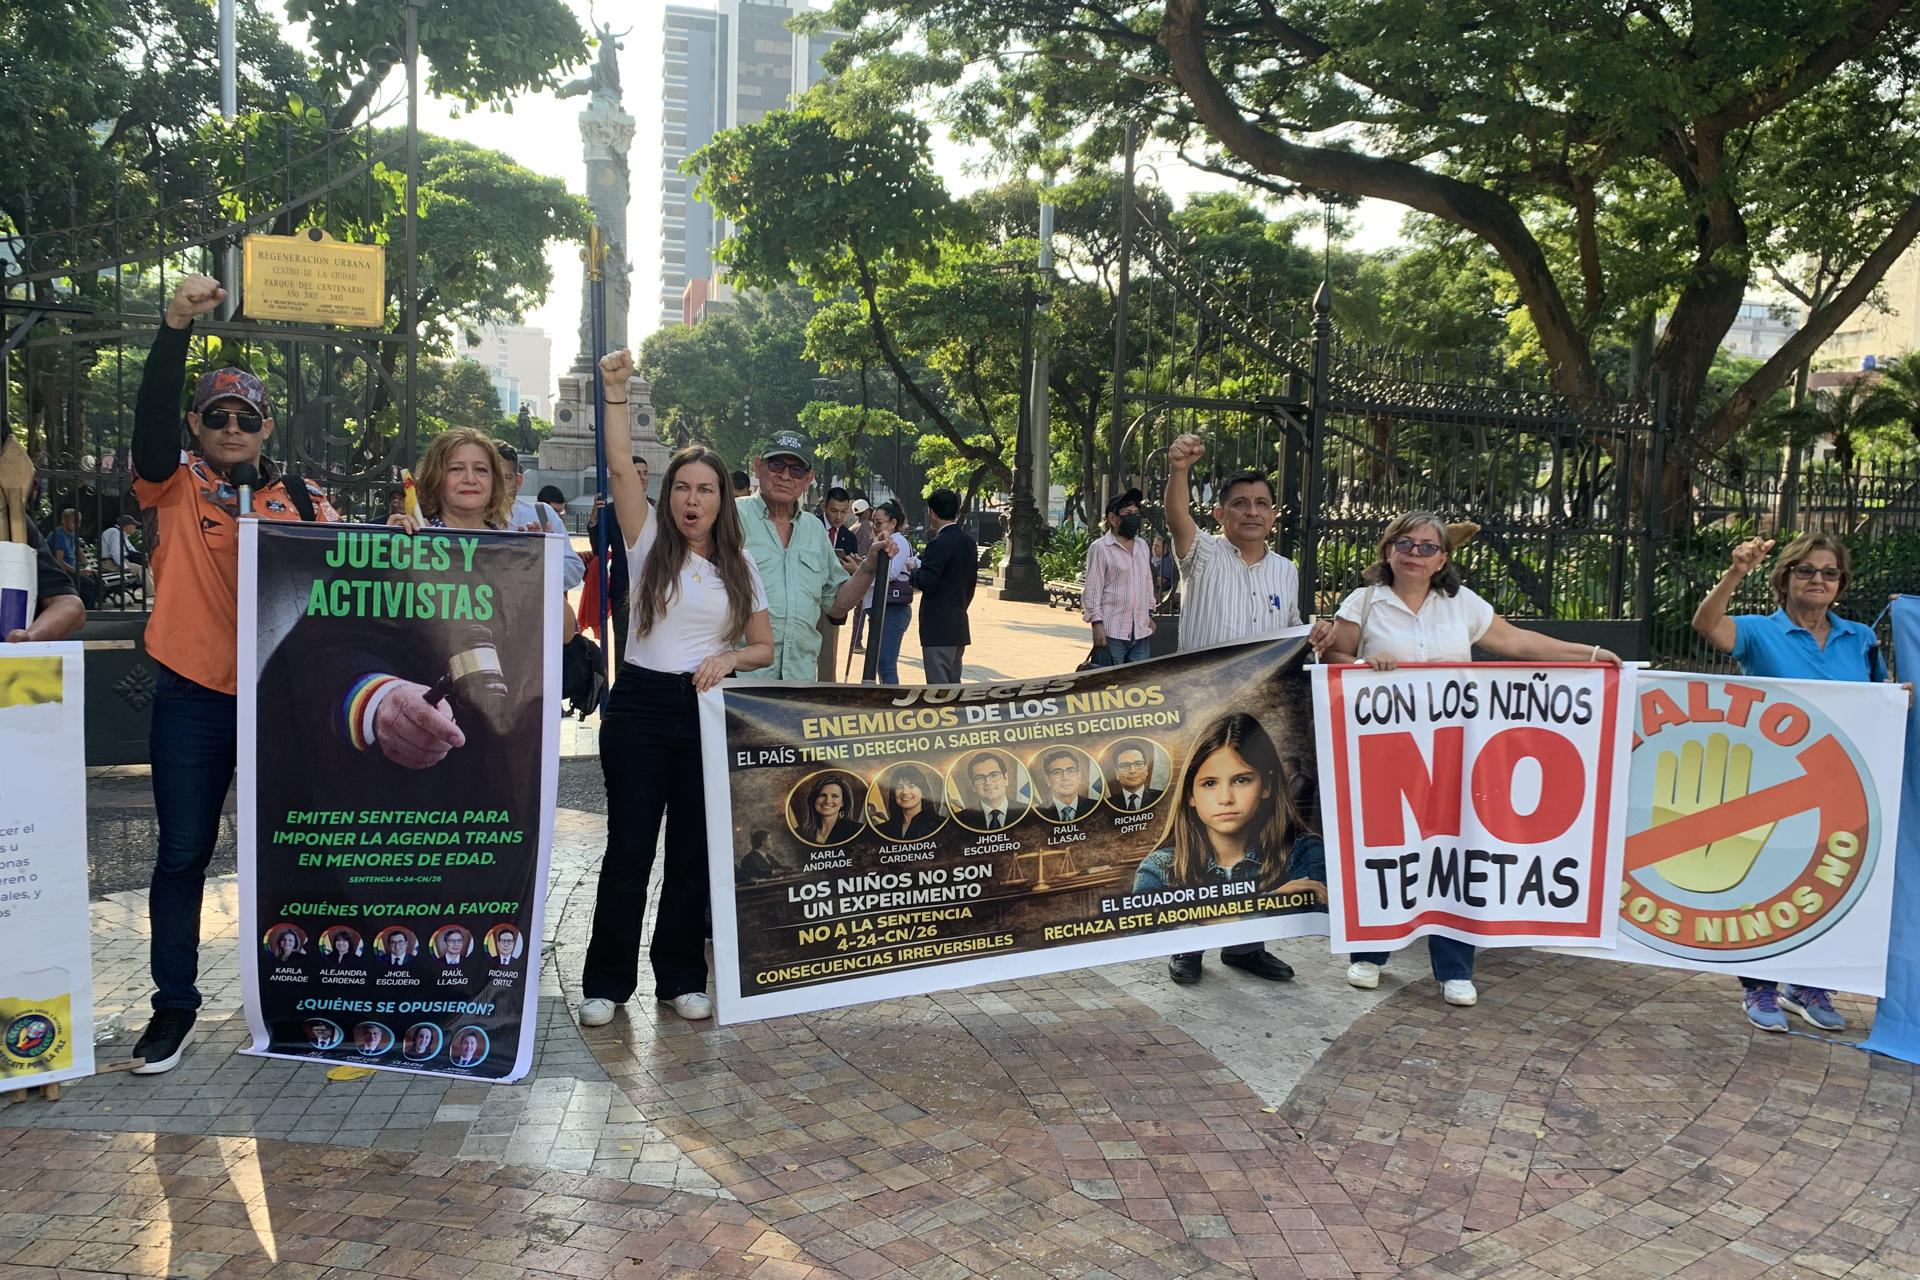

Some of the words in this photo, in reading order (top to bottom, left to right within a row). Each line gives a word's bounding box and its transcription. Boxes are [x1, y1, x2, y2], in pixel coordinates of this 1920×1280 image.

[259, 251, 328, 264] REGENERACION
[335, 258, 370, 269] URBANA
[273, 267, 299, 275] CENTRO
[331, 272, 356, 280] CIUDAD
[264, 279, 294, 288] PARQUE
[318, 284, 364, 294] CENTENARIO
[326, 532, 450, 571] JUECES
[459, 538, 478, 572] Y
[306, 579, 493, 621] ACTIVISTAS
[1355, 683, 1416, 724] CON
[1427, 680, 1479, 722] LOS
[1490, 673, 1592, 724] NIÑOS
[803, 706, 958, 739] ENEMIGOS
[966, 704, 1001, 723] DE
[1009, 698, 1058, 720] LOS
[1066, 685, 1164, 714] NIÑOS
[1640, 681, 1810, 746] ALTO
[737, 752, 755, 766] EL
[760, 746, 795, 764] PAÍS
[799, 744, 848, 762] TIENE
[853, 737, 930, 757] DERECHO
[934, 736, 946, 749] A
[949, 730, 1000, 748] SABER
[1004, 722, 1074, 742] QUIÉNES
[1078, 710, 1180, 734] DECIDIERON
[1358, 726, 1585, 847] NO
[287, 810, 354, 824] EMITEN
[358, 810, 459, 825] SENTENCIA
[463, 810, 509, 823] PARA
[1114, 812, 1154, 826] RICHARD
[23, 823, 34, 833] el
[1054, 823, 1079, 835] RAÚL
[1121, 823, 1147, 833] ORTIZ
[273, 831, 356, 846] IMPONER
[360, 831, 382, 845] LA
[386, 831, 460, 845] AGENDA
[465, 830, 523, 844] TRANS
[976, 833, 1009, 844] JHOEL
[1048, 832, 1086, 845] LLASAG
[810, 850, 845, 861] KARLA
[879, 842, 936, 854] ALEJANDRA
[964, 842, 1020, 856] ESCUDERO
[298, 853, 322, 866] EN
[326, 853, 413, 867] MENORES
[418, 853, 441, 866] DE
[445, 852, 496, 865] EDAD.
[803, 859, 852, 872] ANDRADE
[880, 852, 934, 864] CARDENAS
[396, 875, 442, 883] 4-24-CN/26
[788, 881, 831, 902] LOS
[838, 871, 912, 894] NIÑOS
[918, 869, 947, 884] NO
[953, 864, 992, 880] SON
[34, 889, 42, 899] y
[1695, 886, 1823, 943] NIÑOS
[1815, 831, 1859, 888] NO
[803, 902, 832, 919] UN
[840, 883, 982, 914] EXPERIMENTO
[1102, 900, 1119, 913] EL
[1123, 888, 1195, 910] ECUADOR
[1200, 886, 1217, 900] DE
[1222, 880, 1256, 897] BIEN
[280, 901, 358, 916] ¿QUIÉNES
[363, 903, 440, 916] VOTARON
[444, 903, 455, 915] A
[459, 902, 518, 915] FAVOR?
[1044, 920, 1114, 941] RECHAZA
[1119, 914, 1153, 929] ESTE
[1157, 899, 1253, 925] ABOMINABLE
[1258, 892, 1315, 910] FALLO!!
[799, 926, 830, 946] NO
[835, 922, 847, 937] A
[852, 919, 873, 934] LA
[877, 906, 972, 929] SENTENCIA
[837, 924, 938, 950] 4-24-CN/26
[756, 952, 892, 984] CONSECUENCIAS
[898, 934, 1013, 961] IRREVERSIBLES
[270, 975, 308, 983] ANDRADE
[320, 969, 367, 977] ALEJANDRA
[442, 968, 463, 977] RAÚL
[489, 970, 518, 979] RICHARD
[322, 976, 365, 985] CARDENAS
[296, 998, 373, 1013] ¿QUIÉNES
[377, 1002, 395, 1013] SE
[399, 1002, 495, 1016] OPUSIERON?
